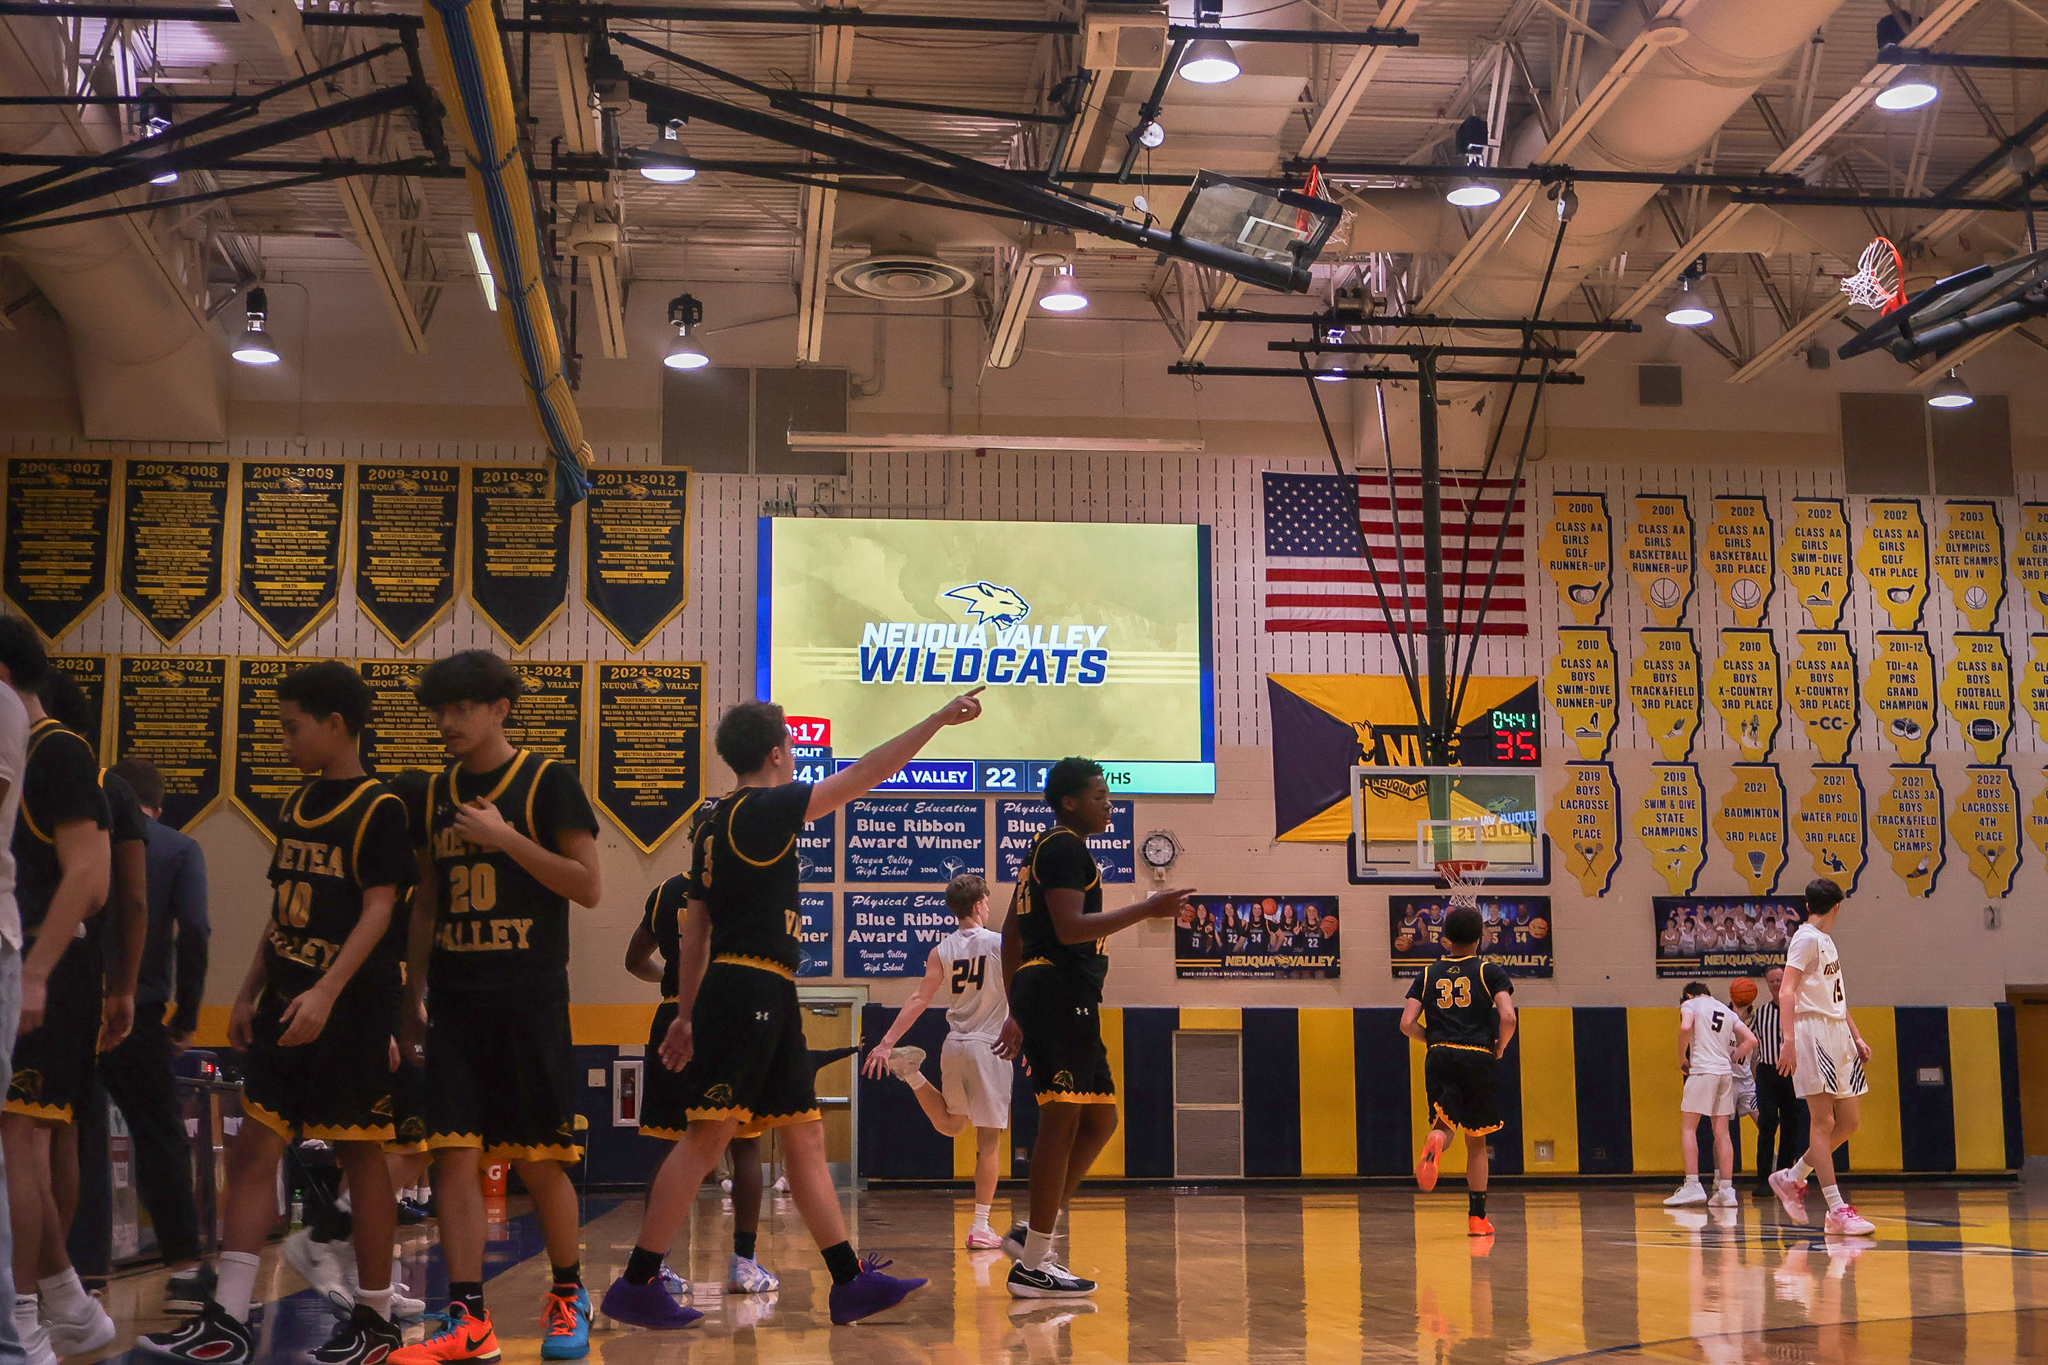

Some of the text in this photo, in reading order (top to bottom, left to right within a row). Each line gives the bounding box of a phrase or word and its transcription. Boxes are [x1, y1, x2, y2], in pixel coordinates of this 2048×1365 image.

[136, 464, 219, 478] 2007-2008
[253, 467, 335, 480] 2008-2009
[368, 469, 449, 482] 2009-2010
[127, 479, 227, 488] NEUQUA VALLEY
[244, 481, 343, 490] NEUQUA VALLEY
[597, 474, 676, 487] 2011-2012
[359, 483, 457, 493] NEUQUA VALLEY
[651, 488, 685, 497] VALLEY
[1569, 503, 1592, 513] 2000
[1731, 507, 1754, 516] 2002
[1884, 510, 1907, 520] 2002
[1960, 512, 1983, 521] 2003
[1556, 522, 1603, 532] CLASS AA
[1719, 525, 1764, 535] CLASS AA
[1873, 529, 1919, 538] CLASS AA
[1949, 530, 1985, 539] SPECIAL
[1563, 535, 1589, 544] GIRLS
[1725, 538, 1751, 548] GIRLS
[1879, 542, 1905, 551] GIRLS
[1946, 543, 1990, 553] OLYMPICS
[1566, 548, 1587, 558] GOLF
[1710, 551, 1767, 561] BASKETBALL
[1882, 555, 1903, 564] GOLF
[1935, 556, 1998, 566] STATE CHAMPS
[1551, 561, 1605, 571] RUNNER-UP
[1716, 564, 1766, 574] 3RD PLACE
[1869, 568, 1918, 577] 4TH PLACE
[1955, 569, 1984, 578] DIV. IV
[862, 622, 1108, 650] NEUQUA VALLEY
[1578, 640, 1598, 649] 2010
[1659, 641, 1680, 650] 2010
[1818, 642, 1836, 651] 2011
[1890, 642, 1923, 652] 2011-12
[1972, 643, 1993, 653] 2012
[132, 660, 213, 674] 2020-2021
[859, 646, 1108, 685] WILDCATS
[1562, 659, 1608, 668] CLASS AA
[1644, 660, 1690, 670] CLASS 3A
[1797, 661, 1849, 670] CLASS AAA
[1886, 661, 1918, 670] TDI-4A
[1958, 662, 2003, 671] CLASS 8A
[610, 667, 691, 680] 2024-2025
[1572, 672, 1595, 681] BOYS
[1653, 673, 1676, 682] BOYS
[1811, 673, 1833, 683] BOYS
[1890, 674, 1915, 683] POMS
[122, 675, 223, 684] NEUQUA VALLEY
[1967, 675, 1989, 684] BOYS
[601, 682, 699, 691] NEUQUA VALLEY
[1557, 685, 1610, 694] SWIM-DIVE
[1631, 686, 1694, 696] TRACK&FIELD
[1796, 686, 1848, 696] X-COUNTRY
[1887, 687, 1918, 696] GRAND
[1957, 688, 2001, 697] FOOTBALL
[1557, 698, 1612, 708] RUNNER-UP
[1642, 699, 1693, 709] 3RD PLACE
[1800, 699, 1850, 709] 3RD PLACE
[1880, 700, 1928, 710] CHAMPION
[1955, 701, 2005, 710] FINAL FOUR
[1493, 711, 1536, 729] 04:41
[1820, 717, 1842, 730] CC
[1496, 731, 1536, 760] 35
[792, 765, 825, 784] :41
[911, 771, 967, 783] VALLEY
[985, 767, 1016, 788] 22
[1579, 772, 1600, 781] 2019
[1664, 772, 1685, 781] 2019
[1977, 775, 2001, 784] 2022
[1824, 776, 1844, 785] 2021
[1372, 779, 1410, 796] NEUQUA
[1577, 786, 1599, 795] BOYS
[1661, 786, 1687, 795] GIRLS
[1745, 783, 1766, 792] 2021
[1819, 794, 1842, 803] BOYS
[1977, 789, 2000, 798] BOYS
[853, 801, 977, 815] Physical Education
[1561, 800, 1609, 810] LACROSSE
[1645, 799, 1695, 809] SWIM & DIVE
[1963, 803, 2009, 812] LACROSSE
[1657, 813, 1684, 823] STATE
[1725, 808, 1779, 818] BADMINTON
[1801, 813, 1857, 822] WATER POLO
[1577, 815, 1595, 824] 3RD
[1980, 818, 1996, 826] 4TH
[857, 819, 965, 832] Blue Ribbon
[1008, 820, 1046, 832] Blue
[1573, 829, 1601, 839] PLACE
[1642, 827, 1697, 836] CHAMPIONS
[1726, 832, 1776, 841] 3RD PLACE
[1975, 832, 2002, 841] PLACE
[849, 836, 981, 849] Award Winner
[1806, 833, 1855, 842] 3RD PLACE
[278, 838, 345, 878] ETEA
[887, 855, 913, 866] Valley
[856, 866, 909, 878] High School
[450, 863, 496, 914] 20
[278, 879, 312, 928] 10
[852, 896, 907, 909] Physical
[856, 912, 896, 926] Blue
[848, 929, 907, 942] Award
[1251, 934, 1261, 943] 34
[1516, 933, 1527, 943] 54
[1308, 939, 1318, 948] 22
[887, 950, 907, 960] Valley
[1704, 954, 1753, 965] NEUQUA
[1225, 956, 1335, 967] NEUQUA VALLEY
[1502, 955, 1547, 966] VALLEY
[864, 963, 904, 973] High School
[951, 955, 987, 994] 24
[1436, 976, 1471, 1009] 33
[1711, 1011, 1724, 1033] 5
[488, 1165, 502, 1180] G
